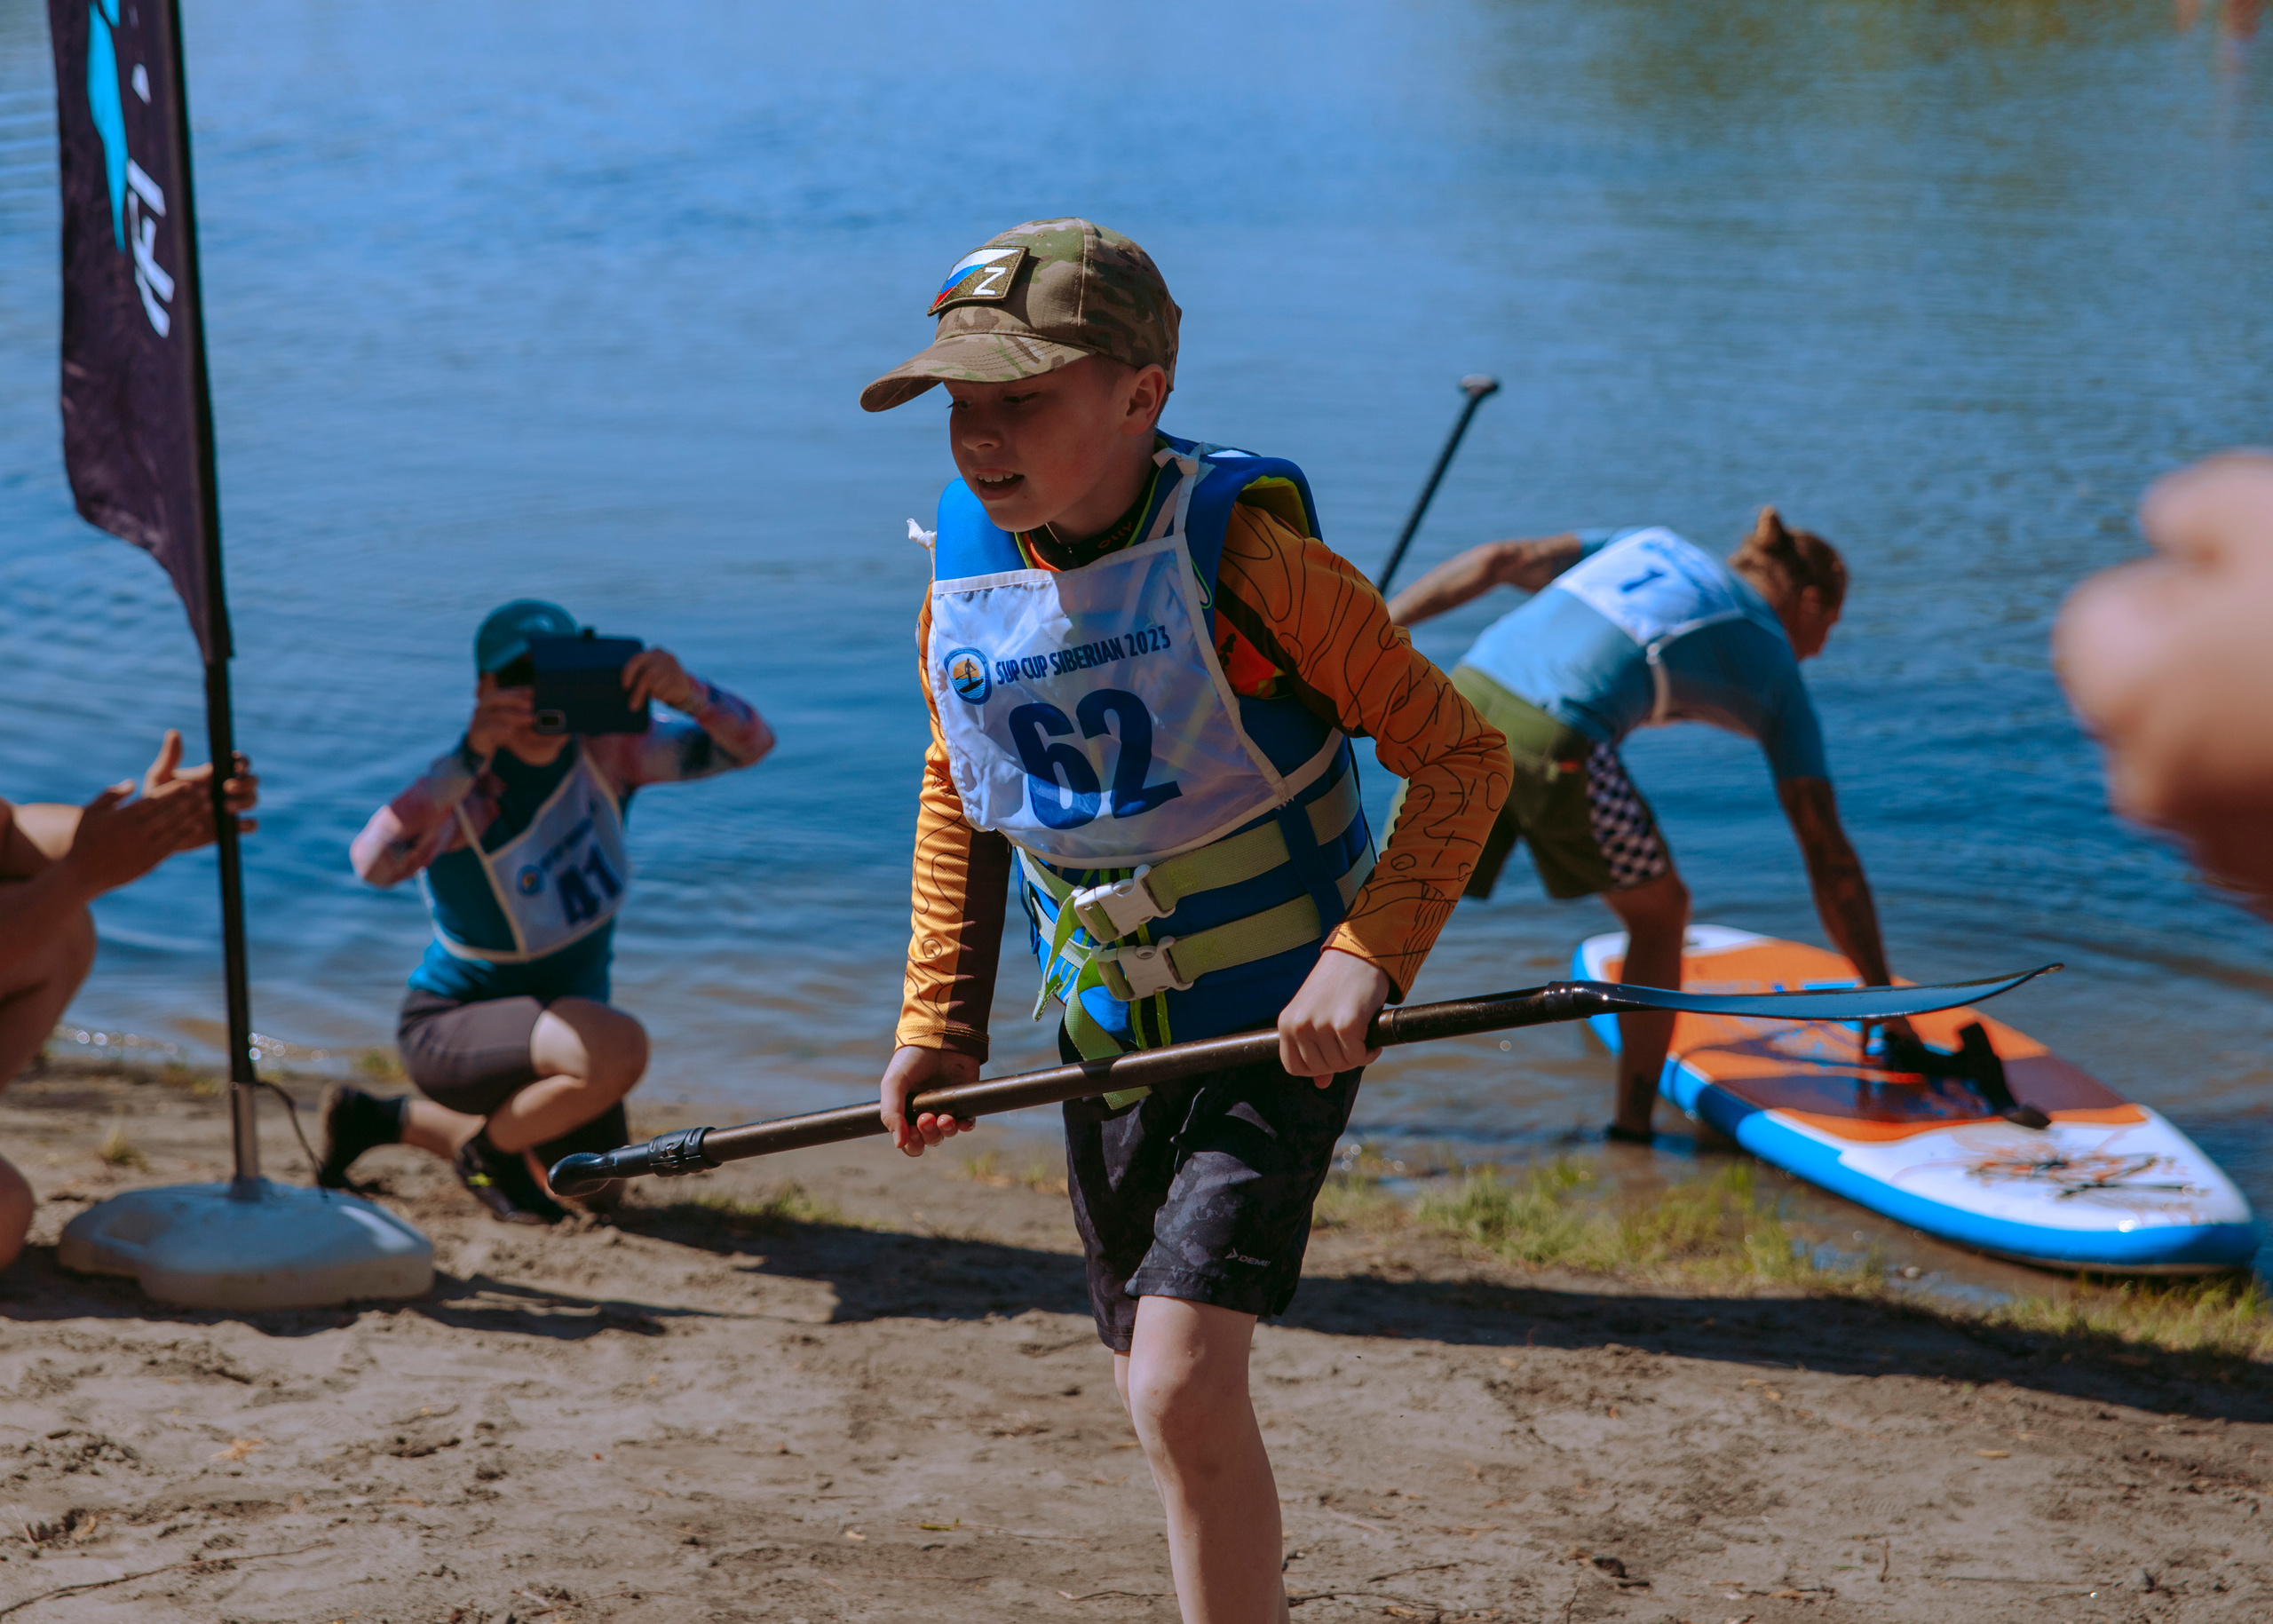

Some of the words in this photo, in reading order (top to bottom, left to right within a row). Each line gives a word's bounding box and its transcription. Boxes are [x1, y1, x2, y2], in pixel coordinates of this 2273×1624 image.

[972, 266, 1007, 296] Z
[995, 659, 1020, 685] SUP
[1021, 654, 1049, 680] CUP
[1049, 637, 1126, 676] SIBERIAN
[1124, 625, 1171, 658] 2023
[1008, 688, 1183, 830] 62
